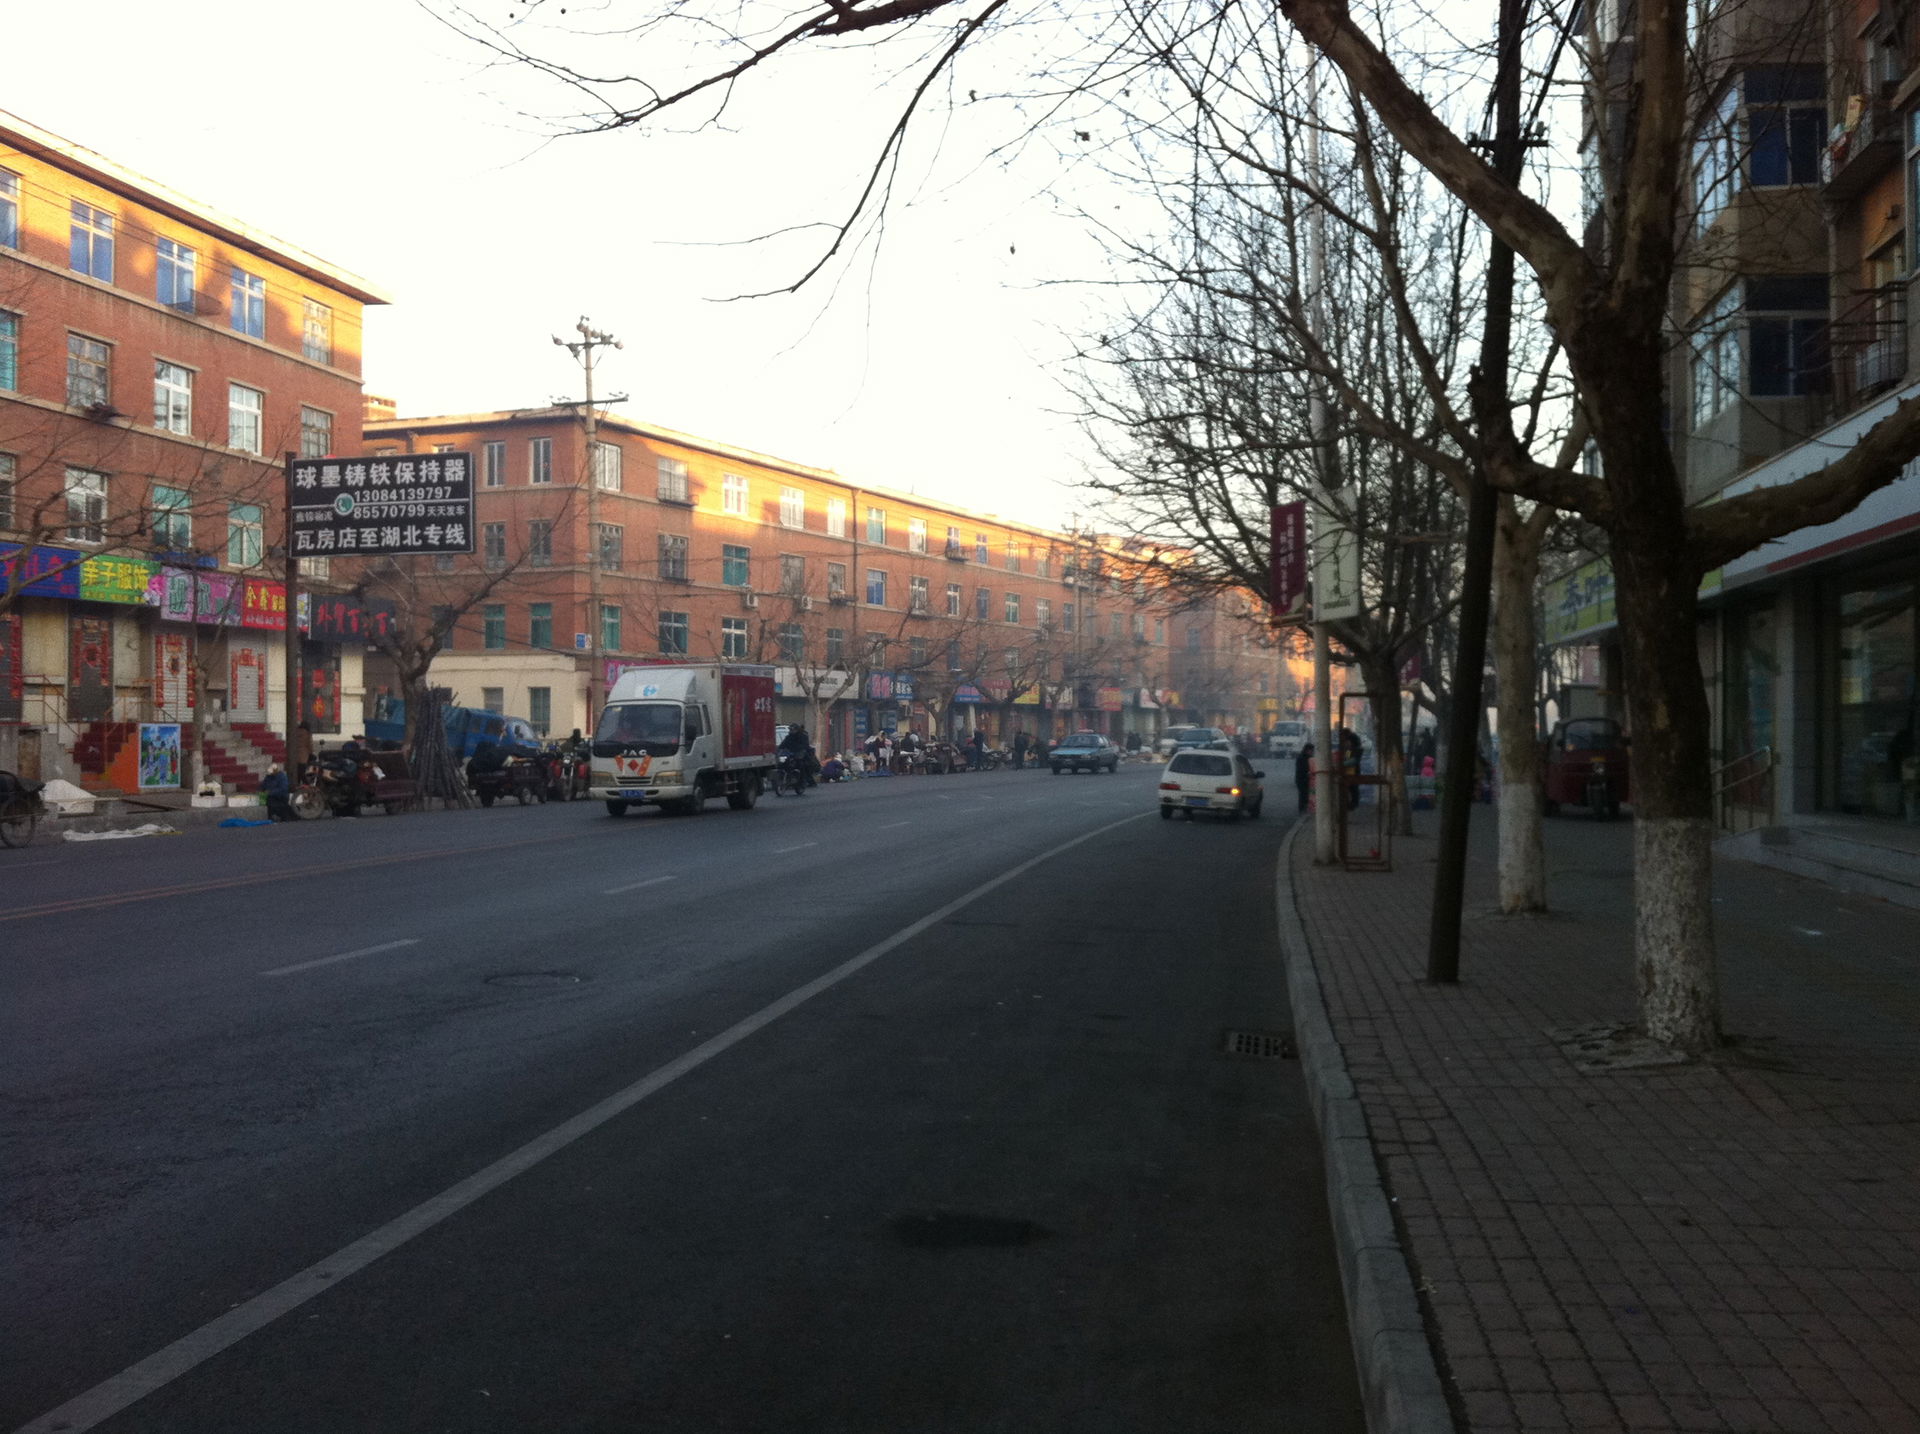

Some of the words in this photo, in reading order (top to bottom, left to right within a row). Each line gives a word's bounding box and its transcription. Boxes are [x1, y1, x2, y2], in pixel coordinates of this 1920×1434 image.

[296, 459, 465, 489] 球墨铸铁保持器
[354, 486, 452, 502] 13084139797
[353, 504, 425, 519] 85570799
[295, 523, 466, 550] 瓦房店至湖北专线
